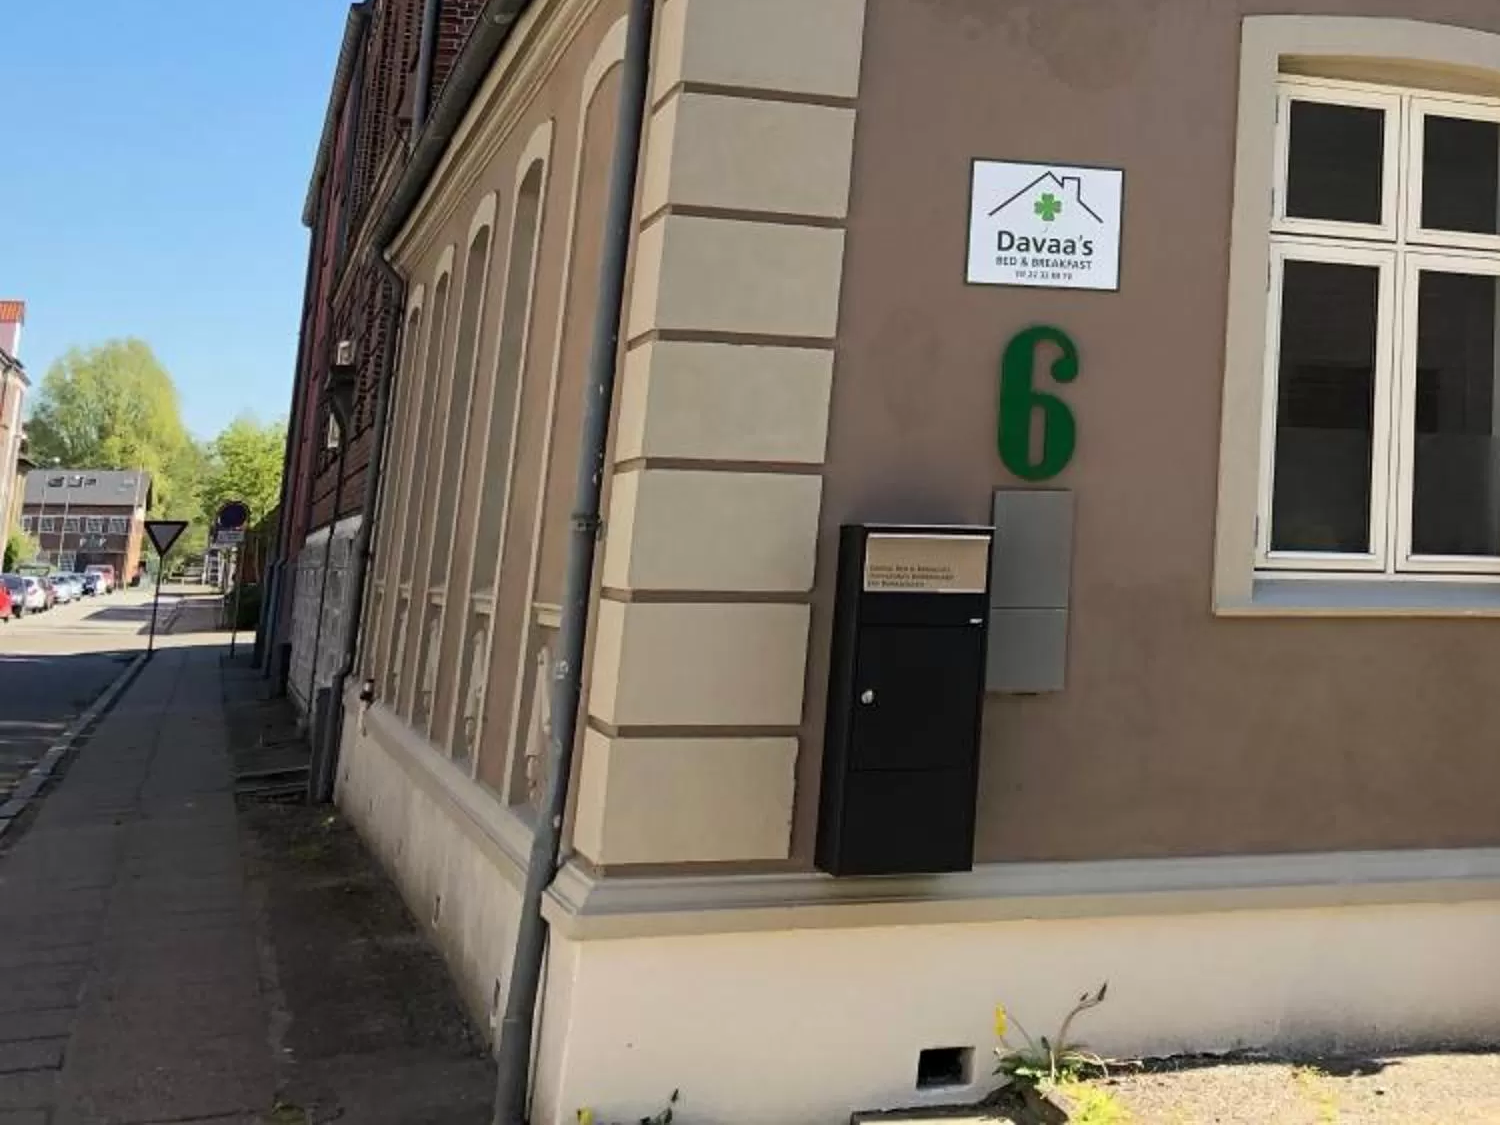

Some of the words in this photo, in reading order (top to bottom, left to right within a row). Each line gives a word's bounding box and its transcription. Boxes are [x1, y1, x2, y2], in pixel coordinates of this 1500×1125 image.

[997, 230, 1094, 256] Davaa's
[995, 256, 1017, 266] BED
[1020, 257, 1029, 267] &
[1031, 258, 1093, 270] BREAKFAST
[998, 325, 1079, 482] 6
